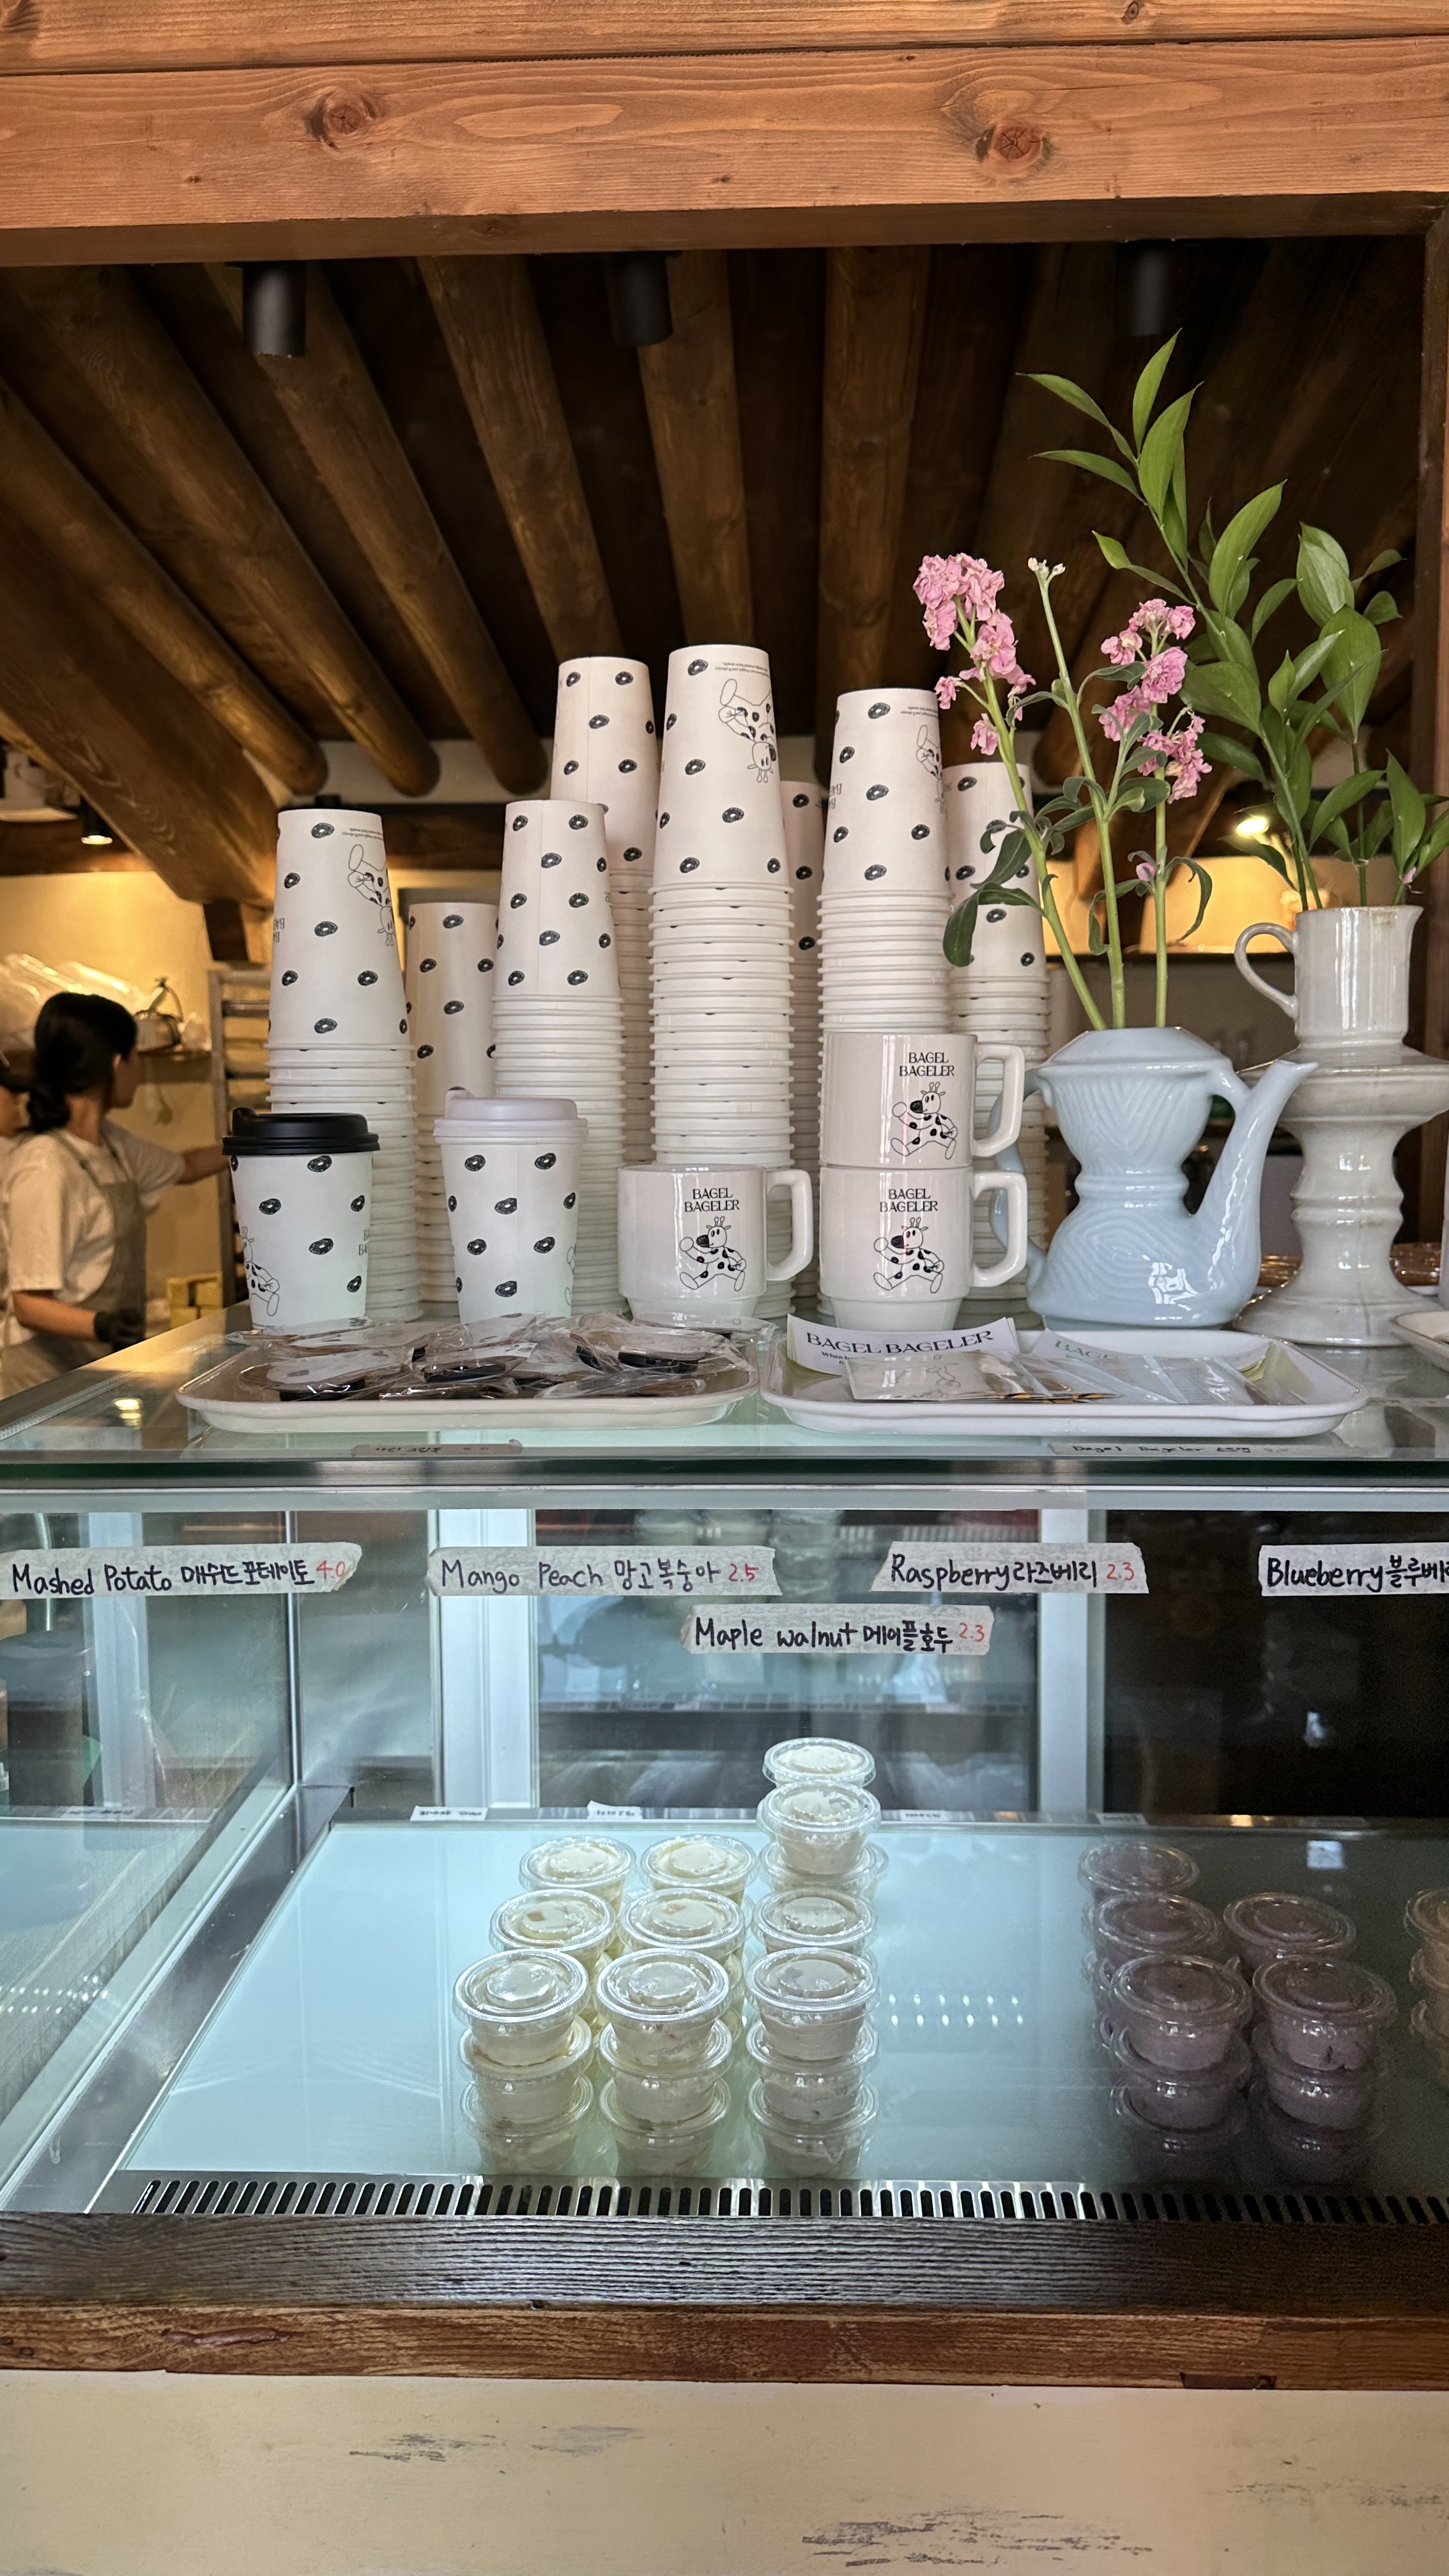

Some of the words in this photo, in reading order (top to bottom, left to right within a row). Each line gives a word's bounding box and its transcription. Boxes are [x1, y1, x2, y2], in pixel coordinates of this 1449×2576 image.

[908, 1052, 949, 1064] BAGEL
[899, 1066, 954, 1077] BAGELER
[693, 1188, 733, 1200] BAGEL
[888, 1188, 931, 1200] BAGEL
[684, 1200, 740, 1213] BAGELER
[880, 1200, 939, 1213] BAGELER
[806, 1332, 882, 1353] BAGEL
[885, 1330, 994, 1353] BAGELER
[1054, 1340, 1109, 1360] BAG
[12, 1563, 95, 1595] Mashed
[104, 1563, 172, 1591] Potato
[441, 1559, 520, 1595] Mango
[539, 1561, 603, 1590] Peach
[728, 1563, 759, 1583] 2.5
[891, 1553, 1009, 1591] Raspberry
[1013, 1560, 1098, 1588] 라즈베리
[1106, 1561, 1135, 1581] 2.3
[1267, 1556, 1383, 1593] Blueberry
[695, 1616, 763, 1650] Maple
[777, 1621, 859, 1648] walnut
[862, 1620, 953, 1653] 메이플호두
[958, 1621, 985, 1643] 2.3
